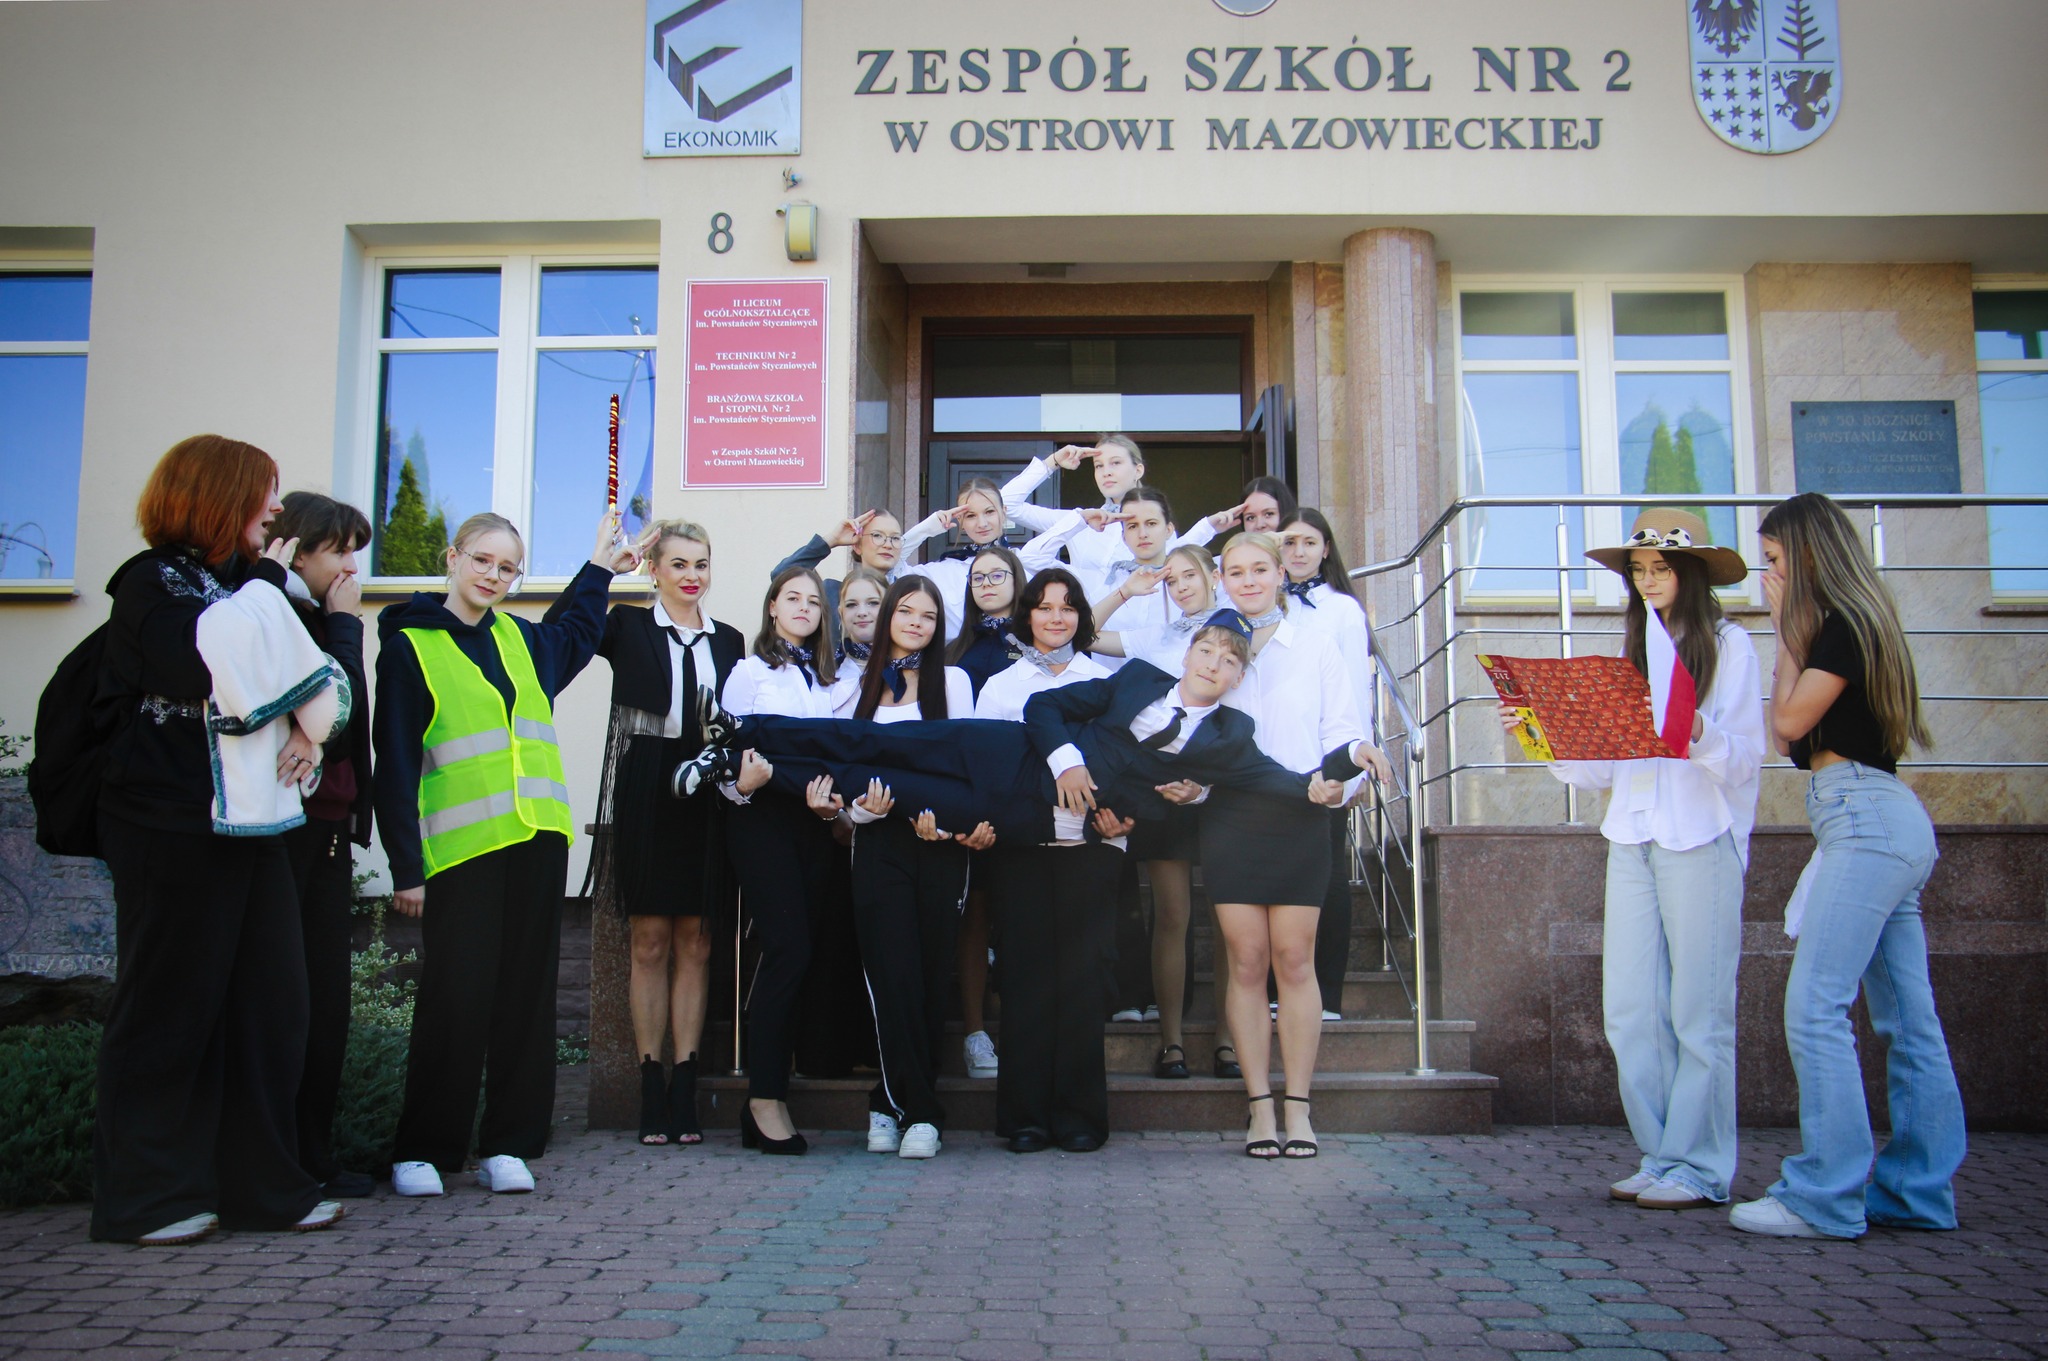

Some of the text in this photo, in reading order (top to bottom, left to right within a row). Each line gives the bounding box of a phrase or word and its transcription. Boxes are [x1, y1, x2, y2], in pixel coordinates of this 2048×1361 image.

[853, 34, 1632, 96] ZESPÓŁ SZKÓŁ NR 2
[664, 130, 778, 148] EKONOMIK
[883, 117, 1604, 154] W OSTROWI MAZOWIECKIEJ
[707, 211, 735, 255] 8
[733, 299, 781, 307] II LICEUM
[703, 308, 811, 318] OGÓLNOKSZTAŁCĄCE
[695, 319, 818, 328] im. Powstańców Styczniowych
[715, 351, 797, 360] TECHNIKUM Nr 2
[694, 362, 817, 371] im. Powstańców Styczniowych
[707, 393, 804, 403] BRANŻOWA SZKOŁA
[720, 405, 724, 413] I
[726, 405, 768, 413] STOPNIA
[693, 415, 817, 424] im. Powstańców Styczniowych
[721, 448, 753, 457] Zespole
[754, 448, 777, 456] Szkół
[779, 448, 791, 456] Nr
[792, 447, 798, 455] 2
[713, 458, 746, 467] Ostrowi
[748, 457, 805, 467] Mazowieckiej
